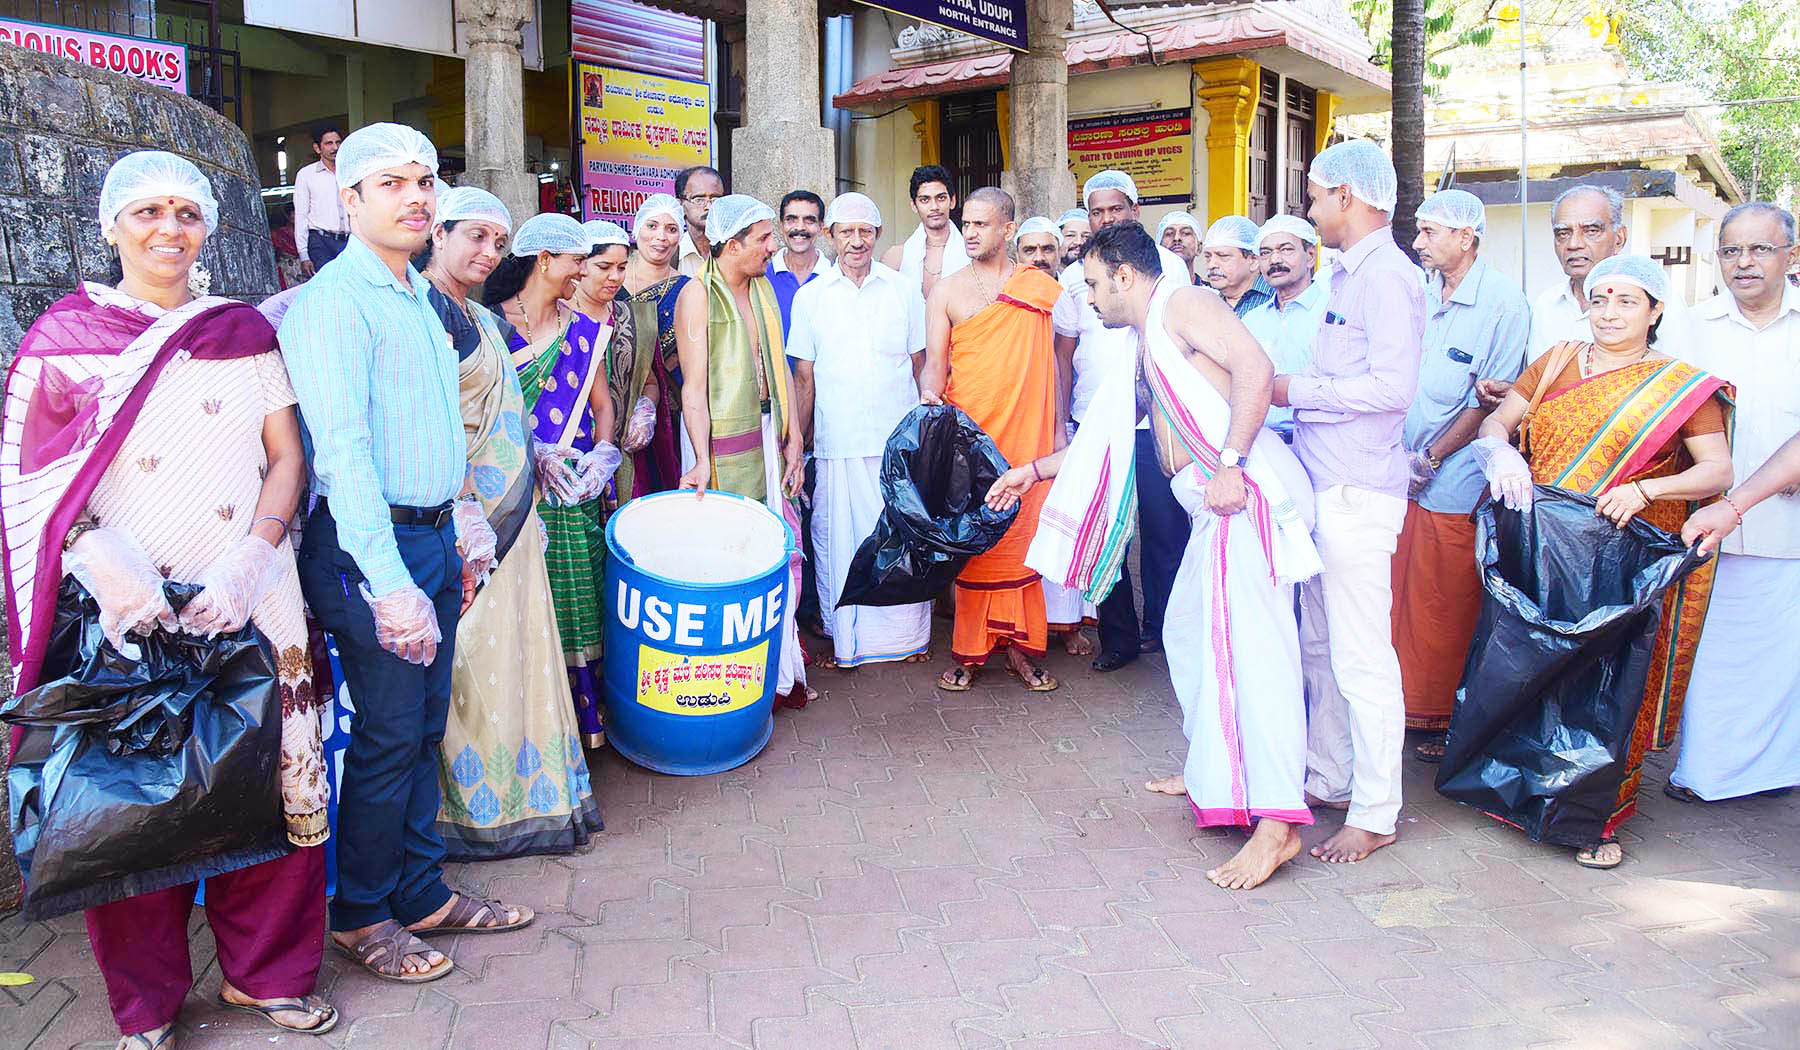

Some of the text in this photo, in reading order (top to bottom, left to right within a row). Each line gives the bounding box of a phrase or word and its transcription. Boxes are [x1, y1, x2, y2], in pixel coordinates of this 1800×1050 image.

[938, 6, 1017, 39] NORTH ENTRANCE
[979, 0, 1012, 23] UDUPI
[89, 41, 181, 80] BOOKS
[1102, 152, 1112, 161] TO
[1114, 149, 1143, 160] GIVING
[1144, 148, 1156, 157] UP
[589, 160, 613, 173] PARYAYA
[614, 163, 632, 176] SHREE
[633, 165, 659, 178] PEJAVARA
[635, 179, 664, 187] UDUPI
[592, 188, 652, 214] RELIGIO
[617, 579, 783, 646] USE ME
[676, 692, 731, 706] ಉಡುಪಿ
